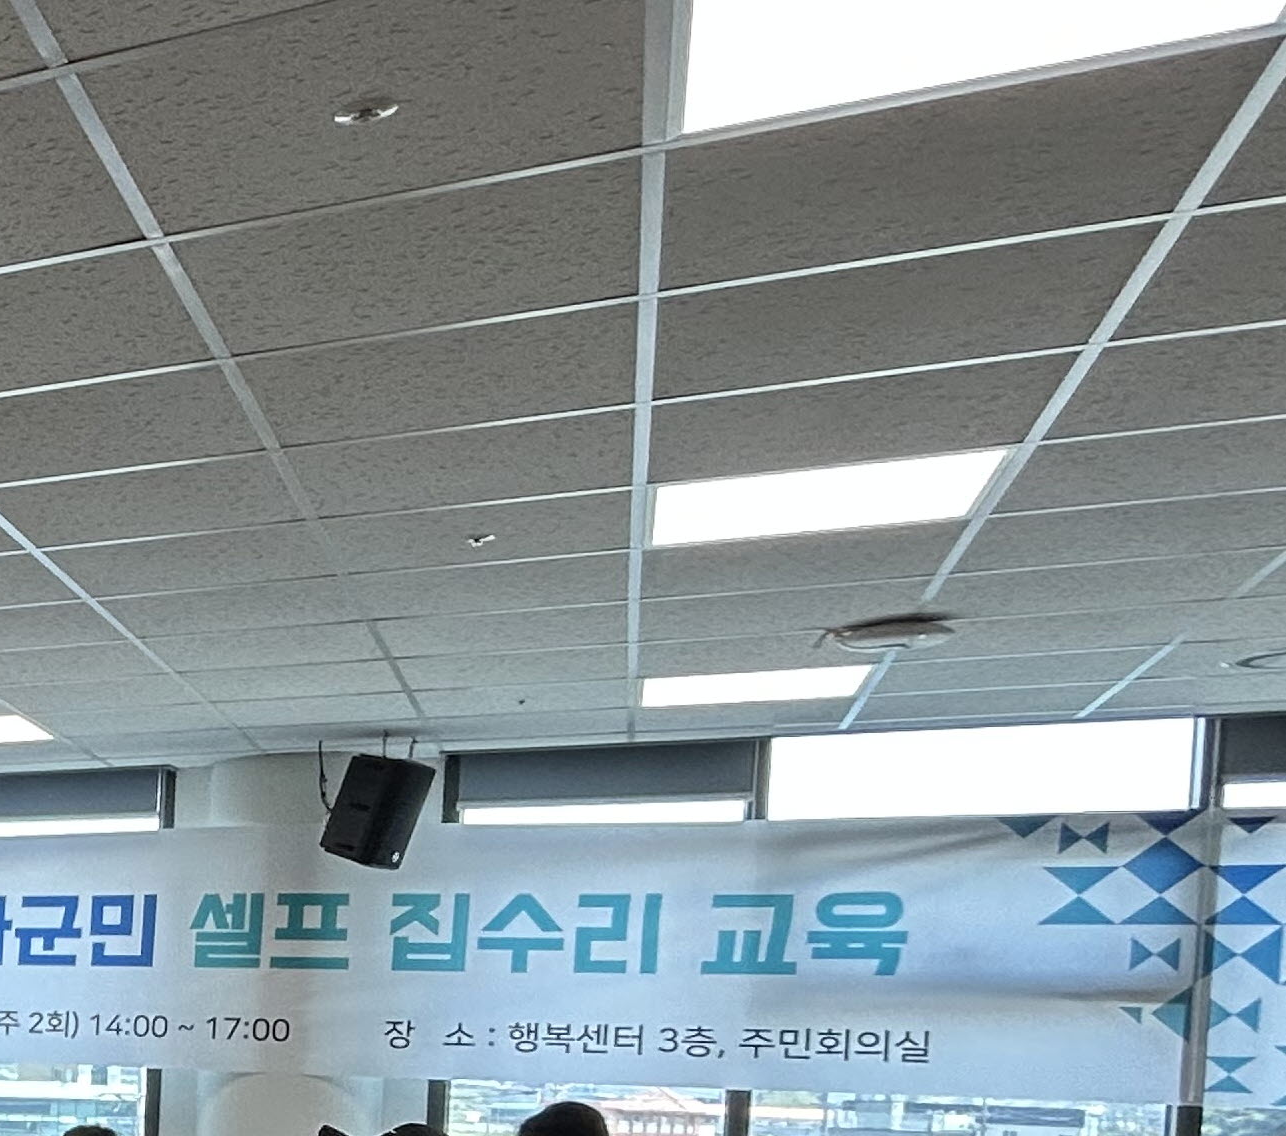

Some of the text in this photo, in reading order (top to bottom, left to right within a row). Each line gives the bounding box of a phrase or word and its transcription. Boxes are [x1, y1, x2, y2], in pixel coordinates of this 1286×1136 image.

[190, 892, 350, 970] 셀프
[388, 892, 663, 975] 집수리
[700, 891, 909, 977] 교육
[90, 1014, 168, 1039] 14:00
[206, 1017, 290, 1042] 17:00
[508, 1021, 644, 1056] 행복센터
[658, 1026, 725, 1059] 3층,
[738, 1028, 930, 1064] 주민회의실
